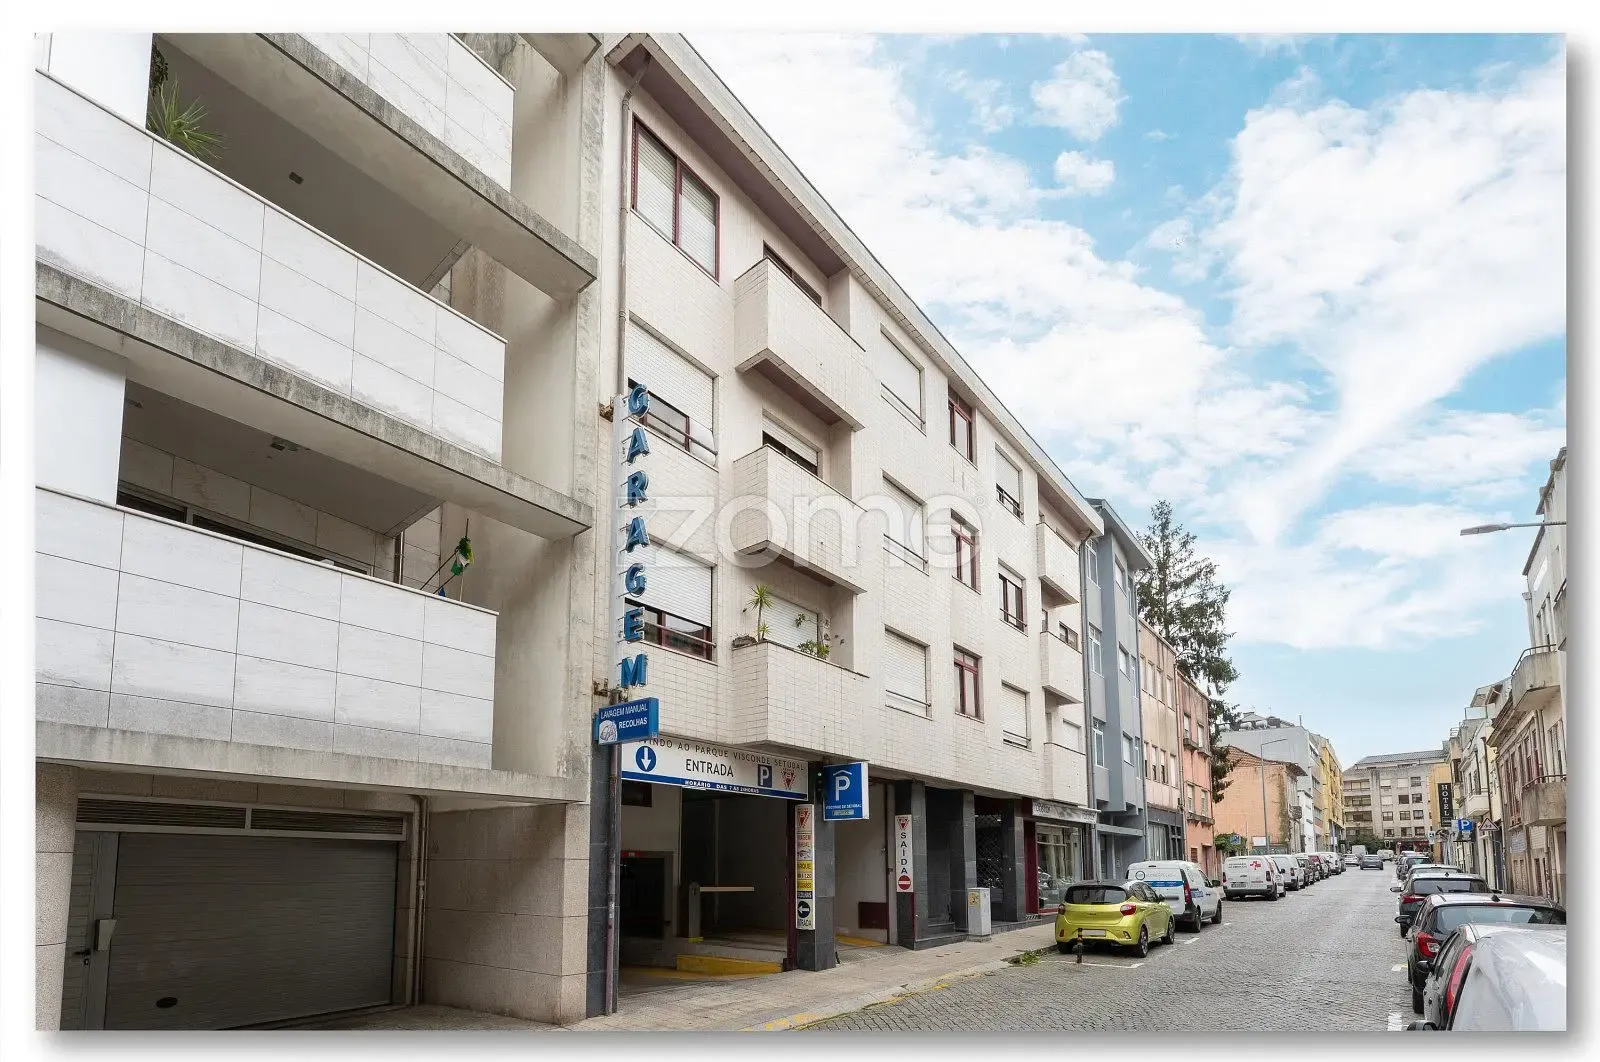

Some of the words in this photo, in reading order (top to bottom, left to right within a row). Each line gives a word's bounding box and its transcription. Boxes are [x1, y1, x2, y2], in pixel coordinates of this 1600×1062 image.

[621, 383, 650, 688] GARAGEM
[601, 707, 625, 720] LAVAGEM
[625, 703, 648, 715] MANUAL
[619, 717, 648, 729] RECOLHAS
[678, 742, 690, 752] AO
[696, 745, 728, 758] PARQUE
[733, 752, 770, 765] VISCONDE
[685, 758, 734, 778] ENTRADA
[760, 766, 770, 786] P
[835, 775, 851, 802] P
[1441, 784, 1450, 816] HOTEL
[1461, 820, 1470, 830] P
